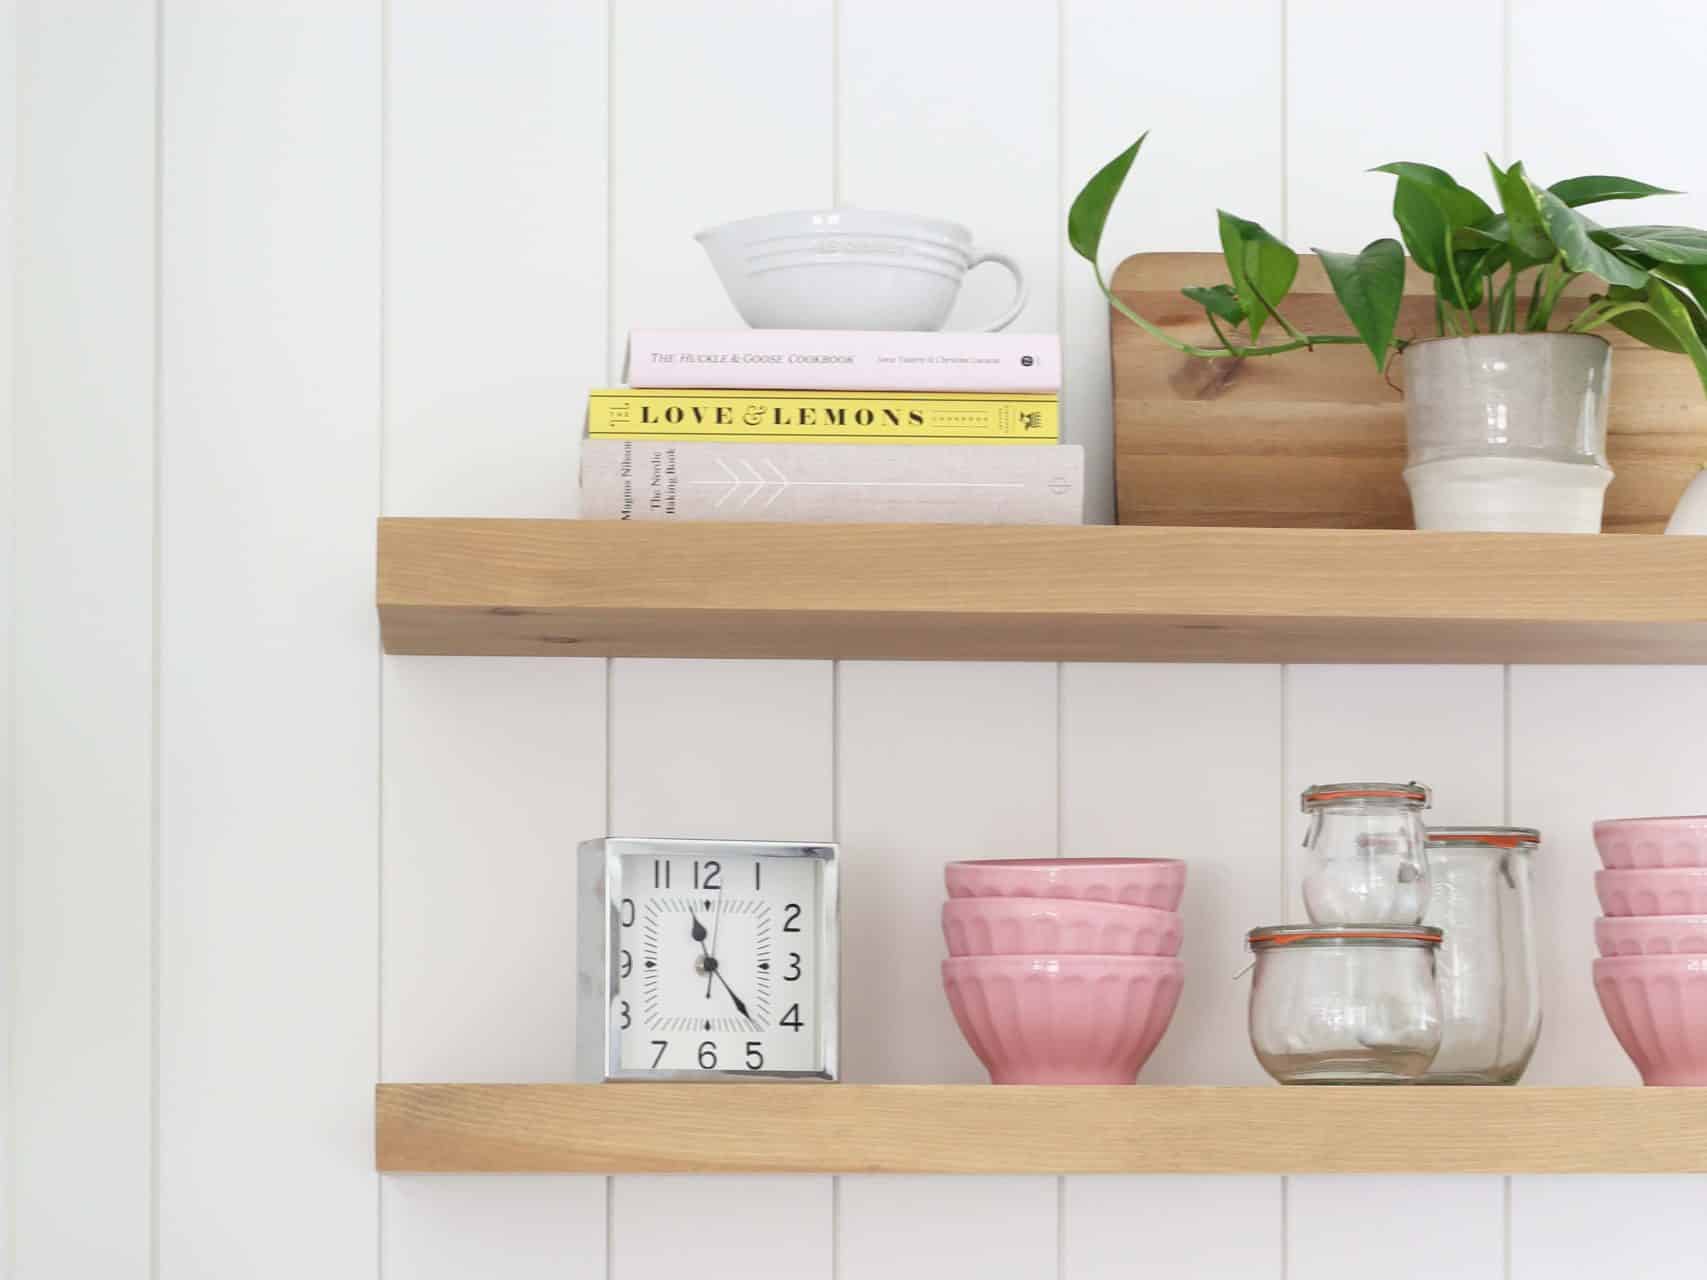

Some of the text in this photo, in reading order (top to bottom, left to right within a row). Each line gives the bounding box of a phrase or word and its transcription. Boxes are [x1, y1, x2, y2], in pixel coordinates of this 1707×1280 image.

[640, 406, 734, 425] LOVE
[743, 404, 768, 426] &
[773, 407, 924, 426] LEMONS
[649, 490, 662, 511] The
[654, 860, 670, 889] 11
[693, 860, 721, 890] 12
[782, 903, 802, 932] 2
[782, 952, 802, 981] 3
[778, 1003, 805, 1032] 4
[650, 1040, 669, 1069] 7
[697, 1041, 717, 1070] 6
[745, 1041, 764, 1070] 5
